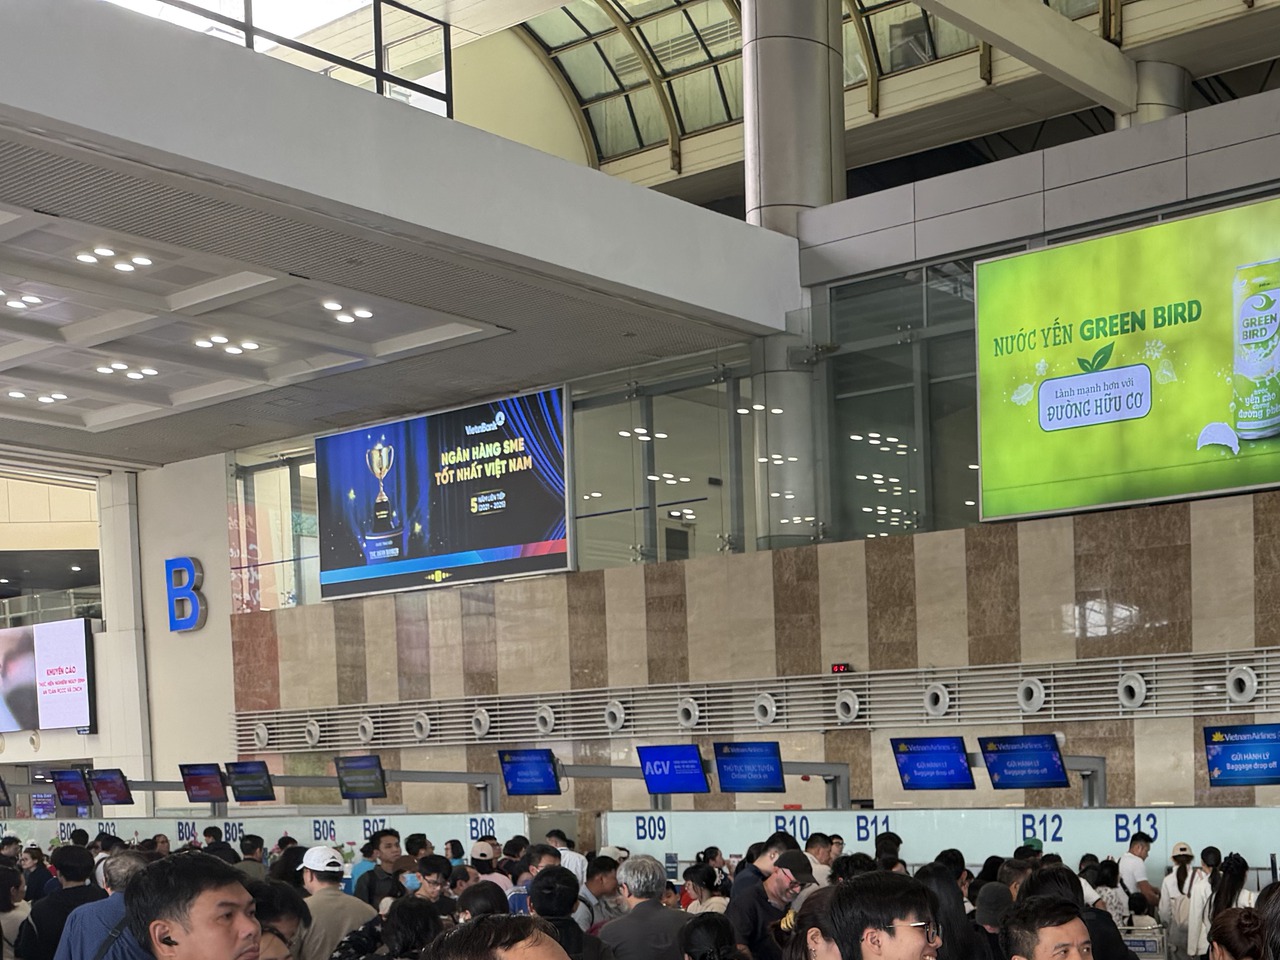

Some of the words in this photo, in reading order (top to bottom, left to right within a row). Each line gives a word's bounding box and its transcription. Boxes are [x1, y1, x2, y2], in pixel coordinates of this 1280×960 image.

[993, 328, 1037, 357] NƯỚC
[1041, 317, 1073, 349] YẾN
[1080, 309, 1147, 342] GREEN
[1154, 300, 1203, 330] BIRD
[1242, 313, 1278, 329] GREEN
[1242, 327, 1268, 342] BIRD
[1055, 387, 1076, 399] Lành
[1077, 385, 1102, 397] mạnh
[1103, 381, 1119, 391] hơn
[1120, 377, 1135, 388] với
[1047, 400, 1091, 422] ĐƯỜNG
[1095, 392, 1123, 416] HỮU
[1126, 391, 1144, 410] CƠ
[441, 446, 471, 467] NGÂN
[472, 442, 502, 460] HÀNG
[503, 437, 525, 454] SME
[434, 466, 455, 486] TỐT
[457, 461, 483, 482] NHẤT
[484, 458, 508, 479] VIỆT
[508, 455, 533, 472] NAM
[470, 497, 479, 513] 5
[165, 556, 206, 633] B
[645, 760, 670, 776] ACV
[178, 821, 196, 841] B04
[224, 822, 245, 842] B05
[313, 820, 336, 841] B06
[363, 818, 386, 840] B07
[470, 818, 495, 840] B08
[636, 816, 666, 841] B09
[775, 815, 810, 841] B10
[857, 815, 890, 841] B11
[1022, 814, 1063, 843] B12
[1115, 813, 1159, 843] B13
